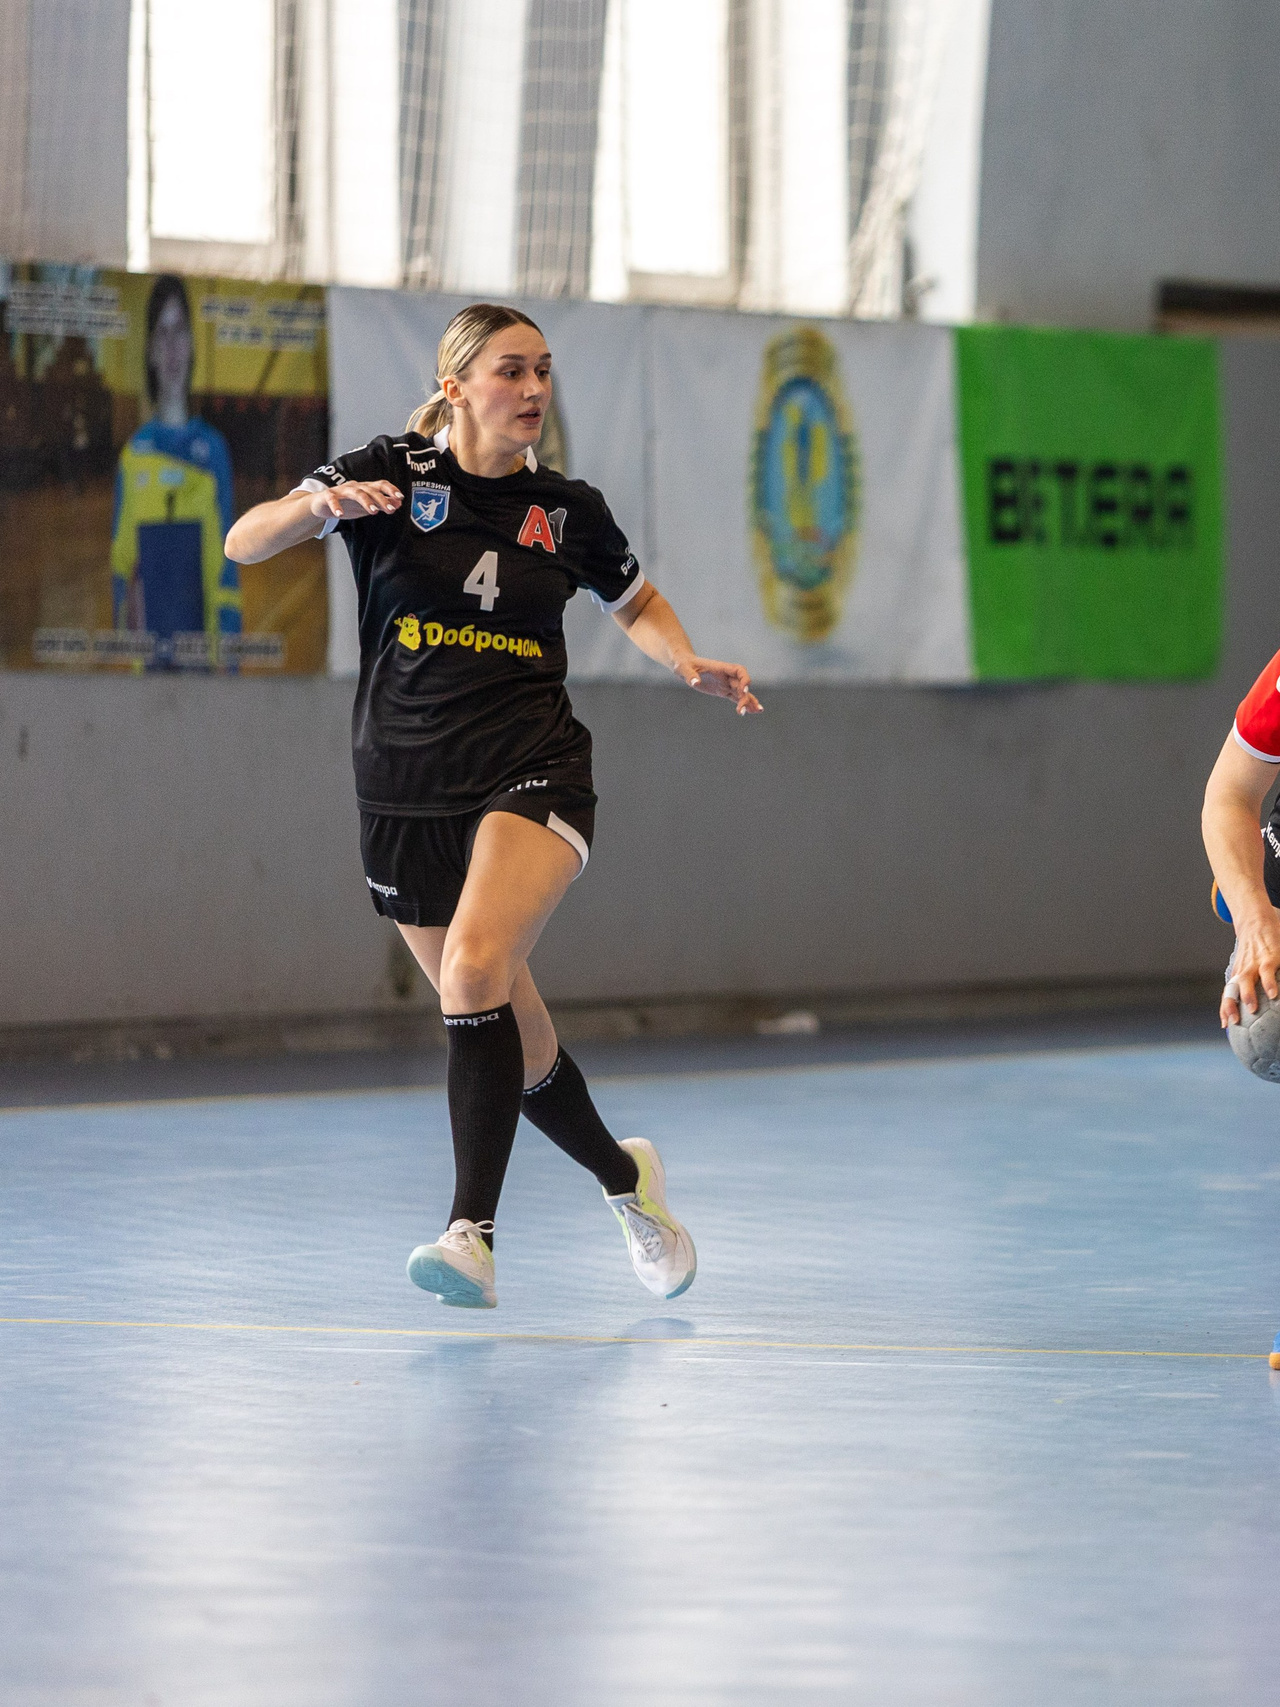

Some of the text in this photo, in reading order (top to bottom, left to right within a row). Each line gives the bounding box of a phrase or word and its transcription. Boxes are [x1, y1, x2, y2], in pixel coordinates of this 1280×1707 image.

[412, 481, 451, 491] БЕРЕЗИНА
[517, 505, 568, 554] A1
[463, 551, 500, 612] 4
[423, 622, 544, 658] Доброном
[443, 1012, 500, 1027] empa
